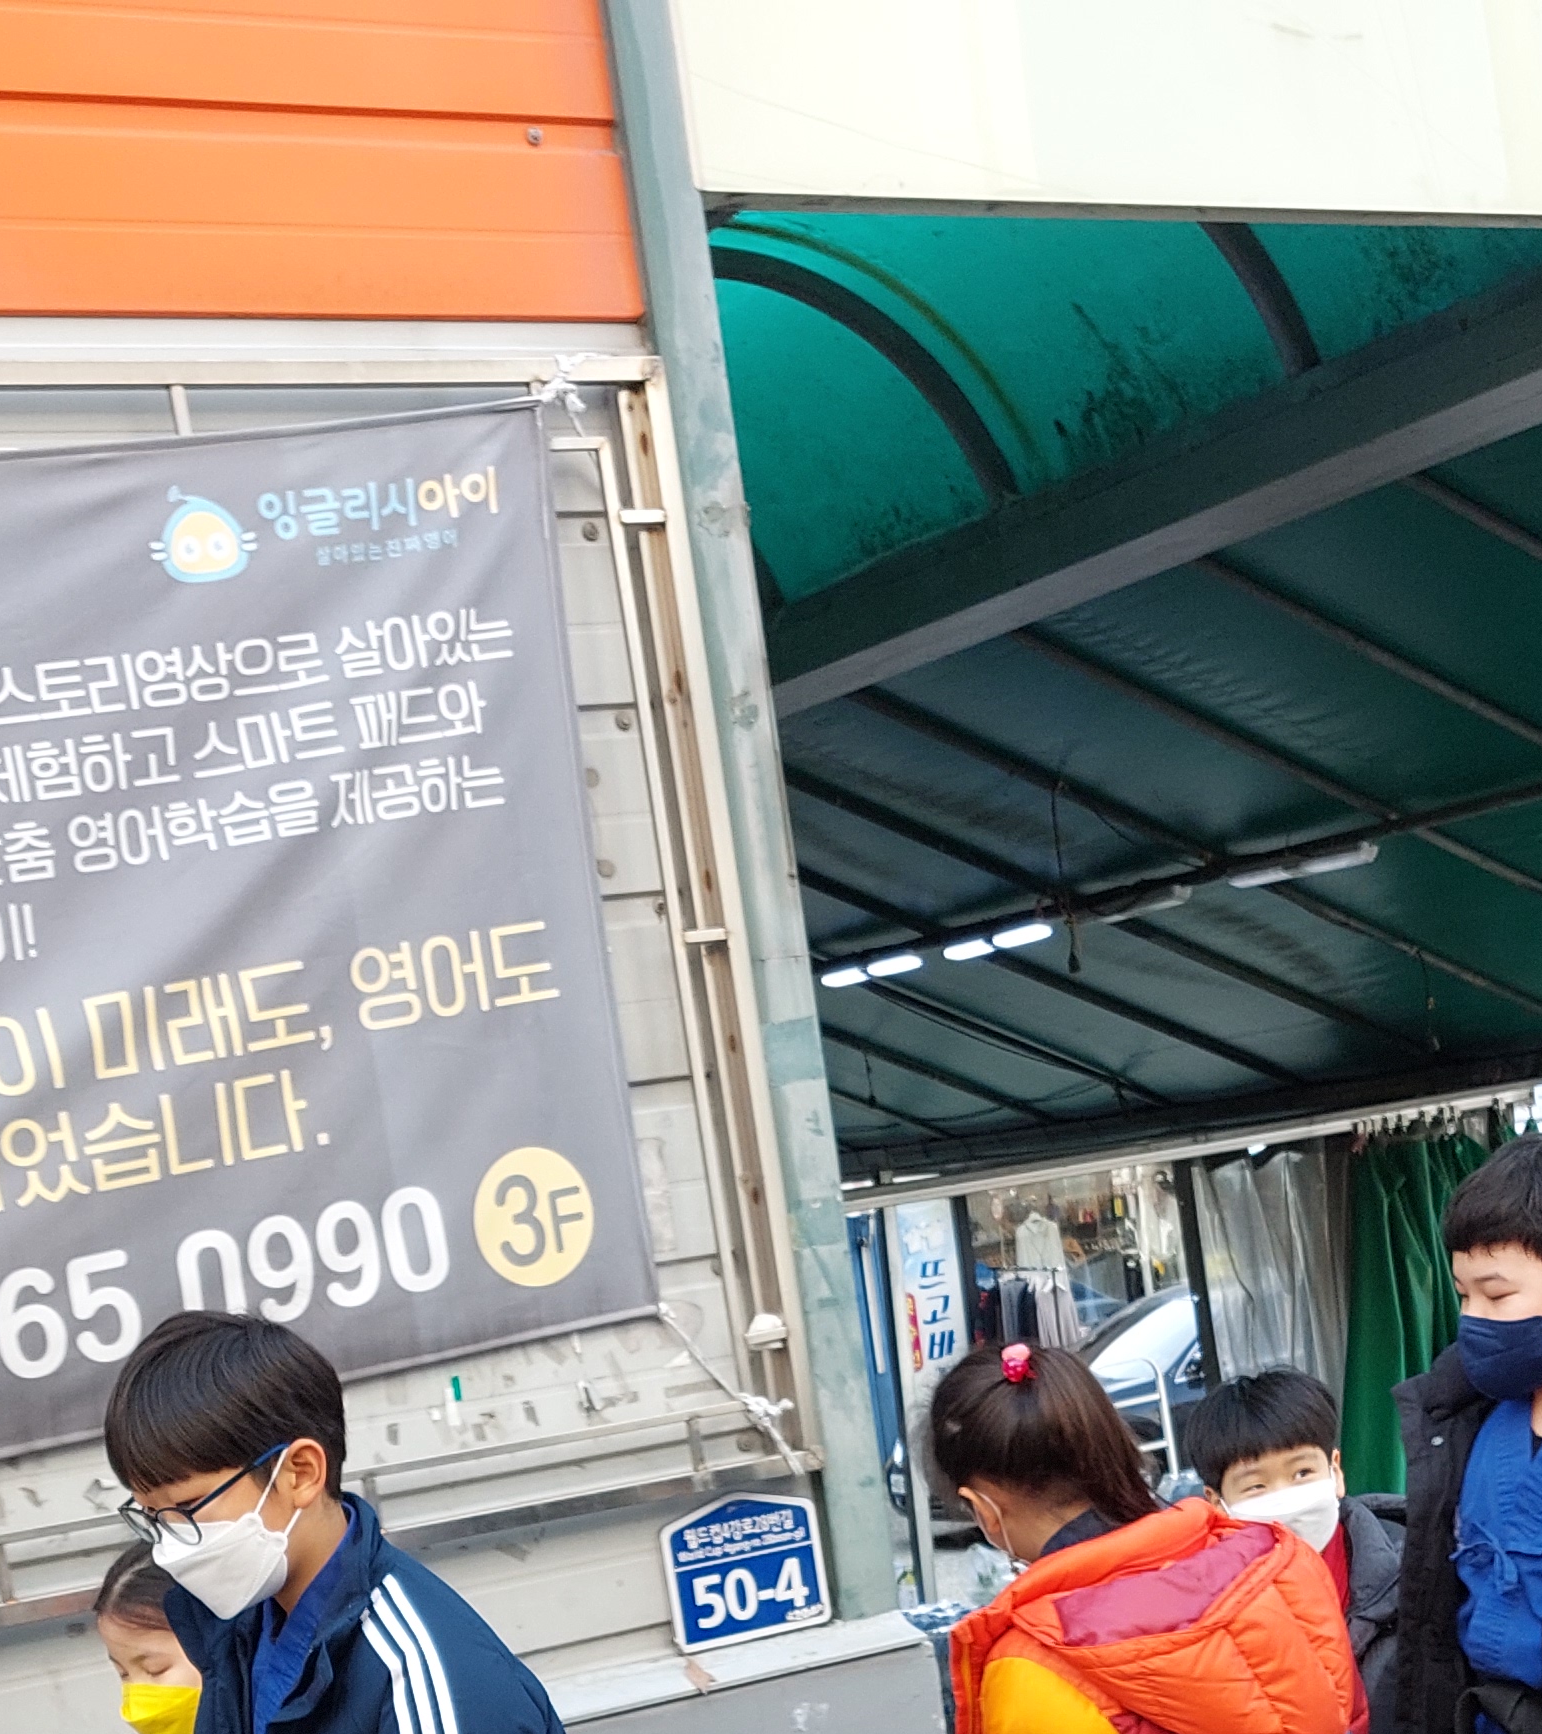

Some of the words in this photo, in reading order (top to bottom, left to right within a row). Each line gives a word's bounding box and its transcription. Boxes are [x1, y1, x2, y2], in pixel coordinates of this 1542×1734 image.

[258, 465, 499, 540] 잉글리시아이
[334, 607, 515, 679] 살아있는
[193, 701, 346, 779] 스마트
[349, 680, 487, 751] 패드와
[67, 778, 321, 874] 영어학습을
[330, 755, 506, 829] 제공하는
[84, 960, 335, 1082] 미래도,
[349, 921, 561, 1032] 영어도
[175, 1185, 451, 1324] 0990
[495, 1172, 587, 1268] 3F
[692, 1557, 809, 1629] 50-4
